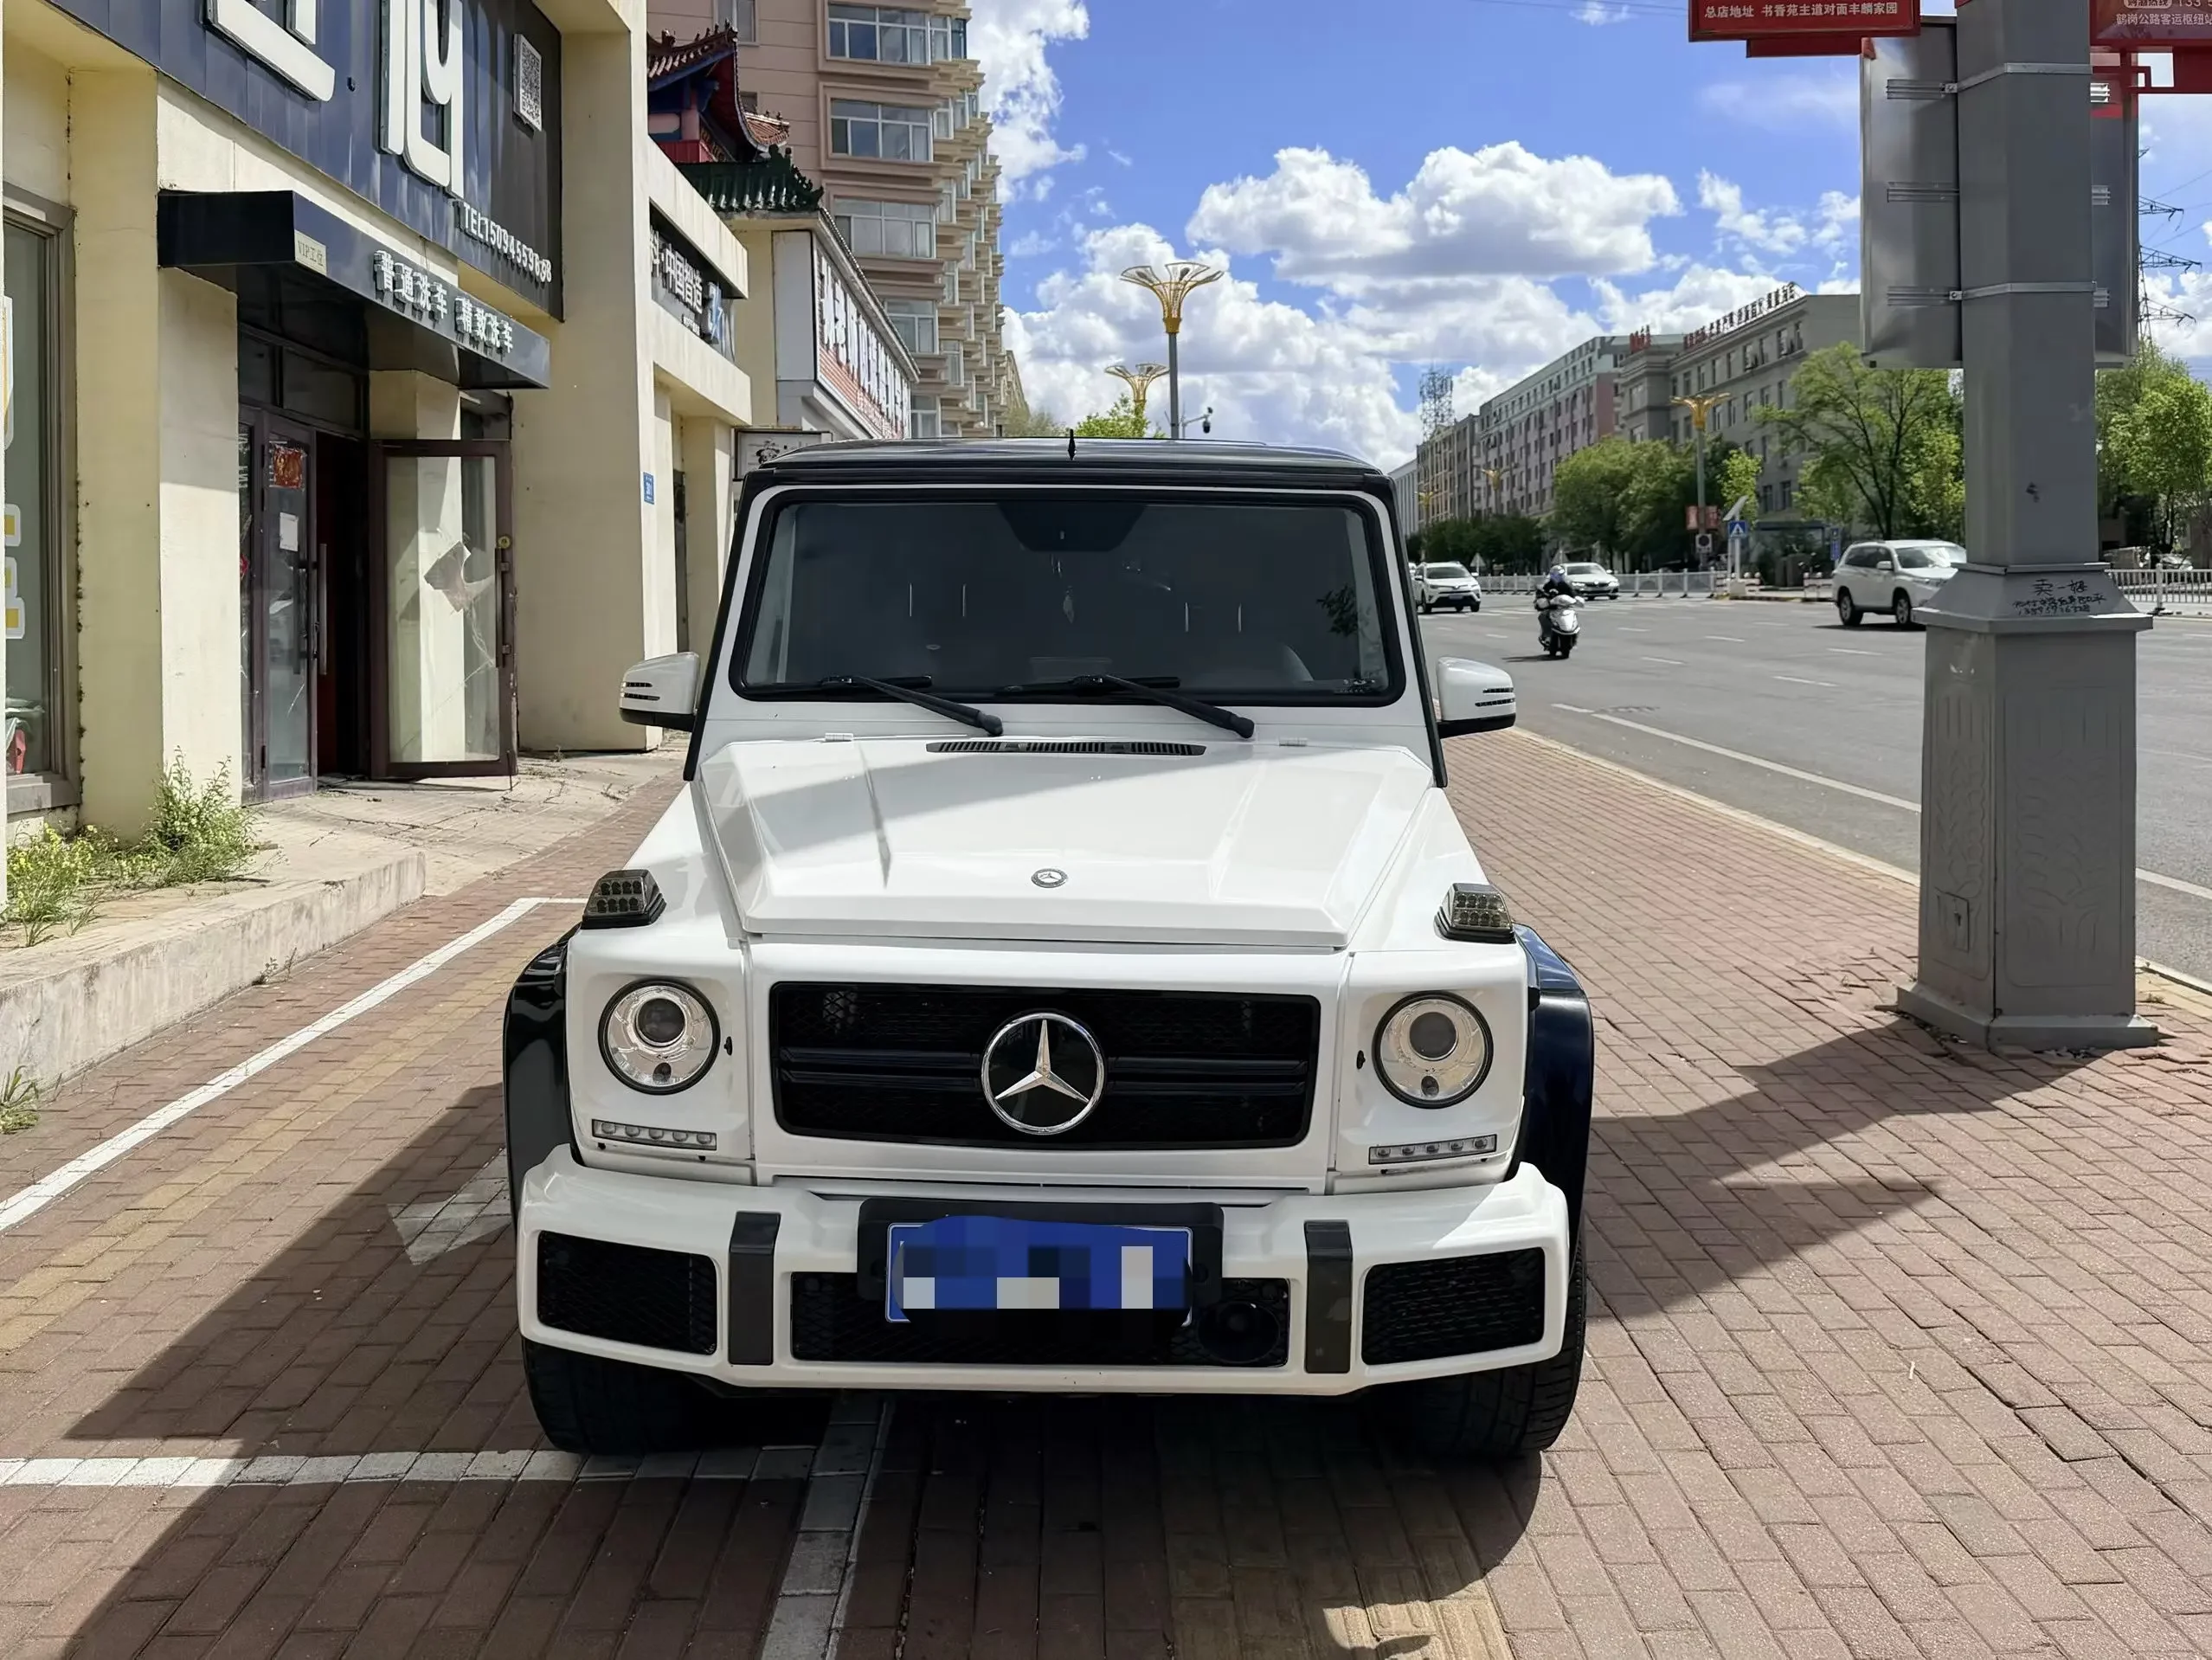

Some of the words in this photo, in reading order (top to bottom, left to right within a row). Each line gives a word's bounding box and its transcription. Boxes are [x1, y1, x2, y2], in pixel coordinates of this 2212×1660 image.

[1705, 5, 1754, 18] 总店地址
[1761, 3, 1898, 16] 书香苑主道对面丰麟家园
[2116, 13, 2212, 25] 鹤岗公路客运枢纽站
[376, 250, 447, 319] 普通洗车
[457, 296, 513, 353] 精致洗车
